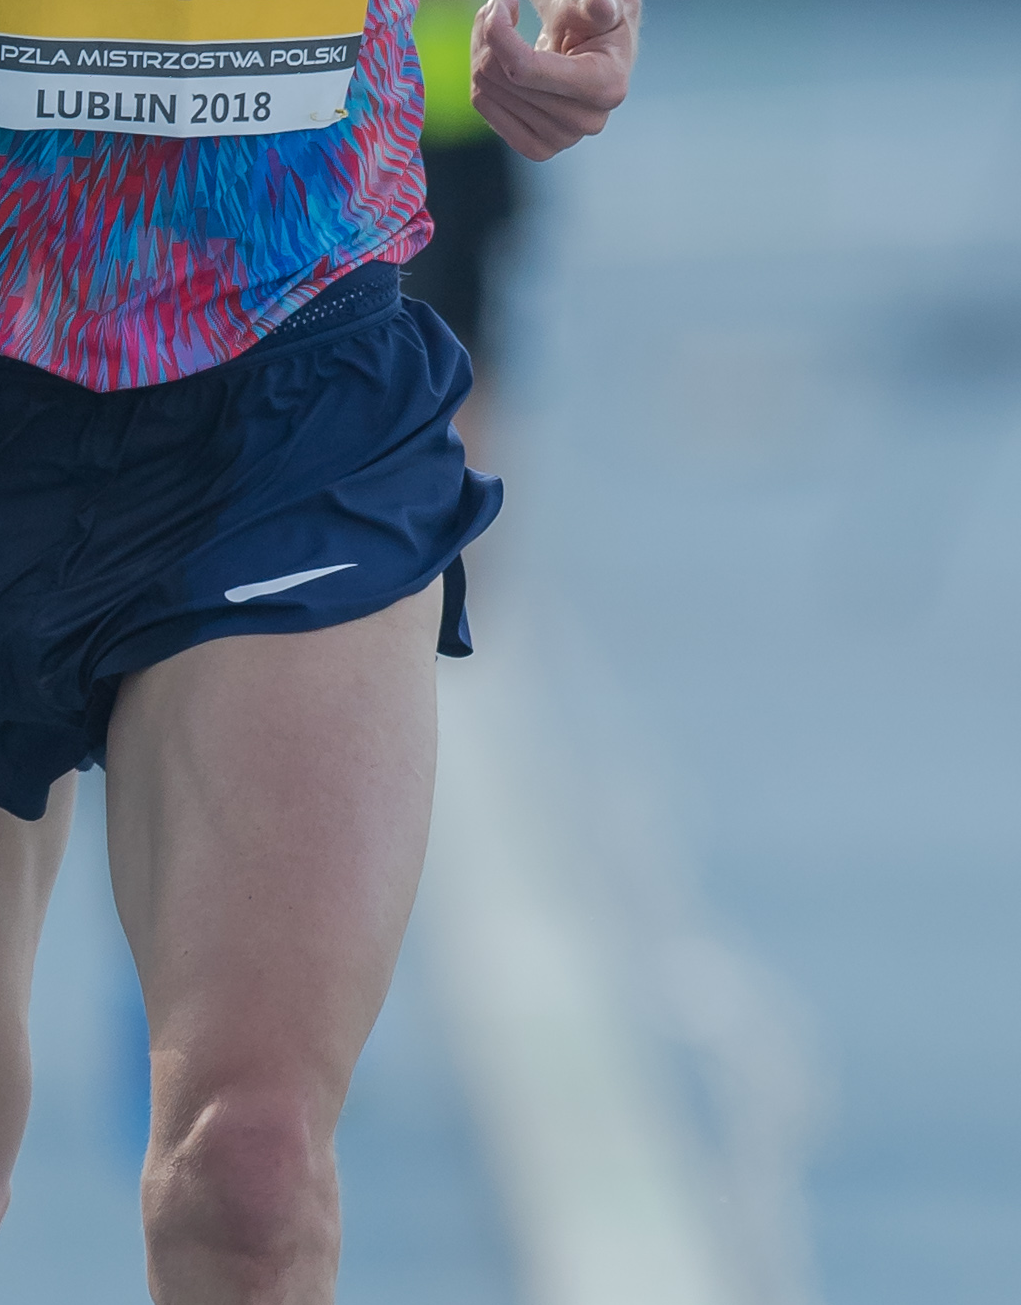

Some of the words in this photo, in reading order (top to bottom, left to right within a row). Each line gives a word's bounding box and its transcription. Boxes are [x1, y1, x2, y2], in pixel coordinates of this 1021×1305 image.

[1, 44, 71, 66] PZLA
[77, 49, 265, 70] MISTRZOSTWA
[270, 45, 347, 68] POLSKI
[36, 89, 177, 124] LUBLIN
[190, 91, 272, 125] 2018
